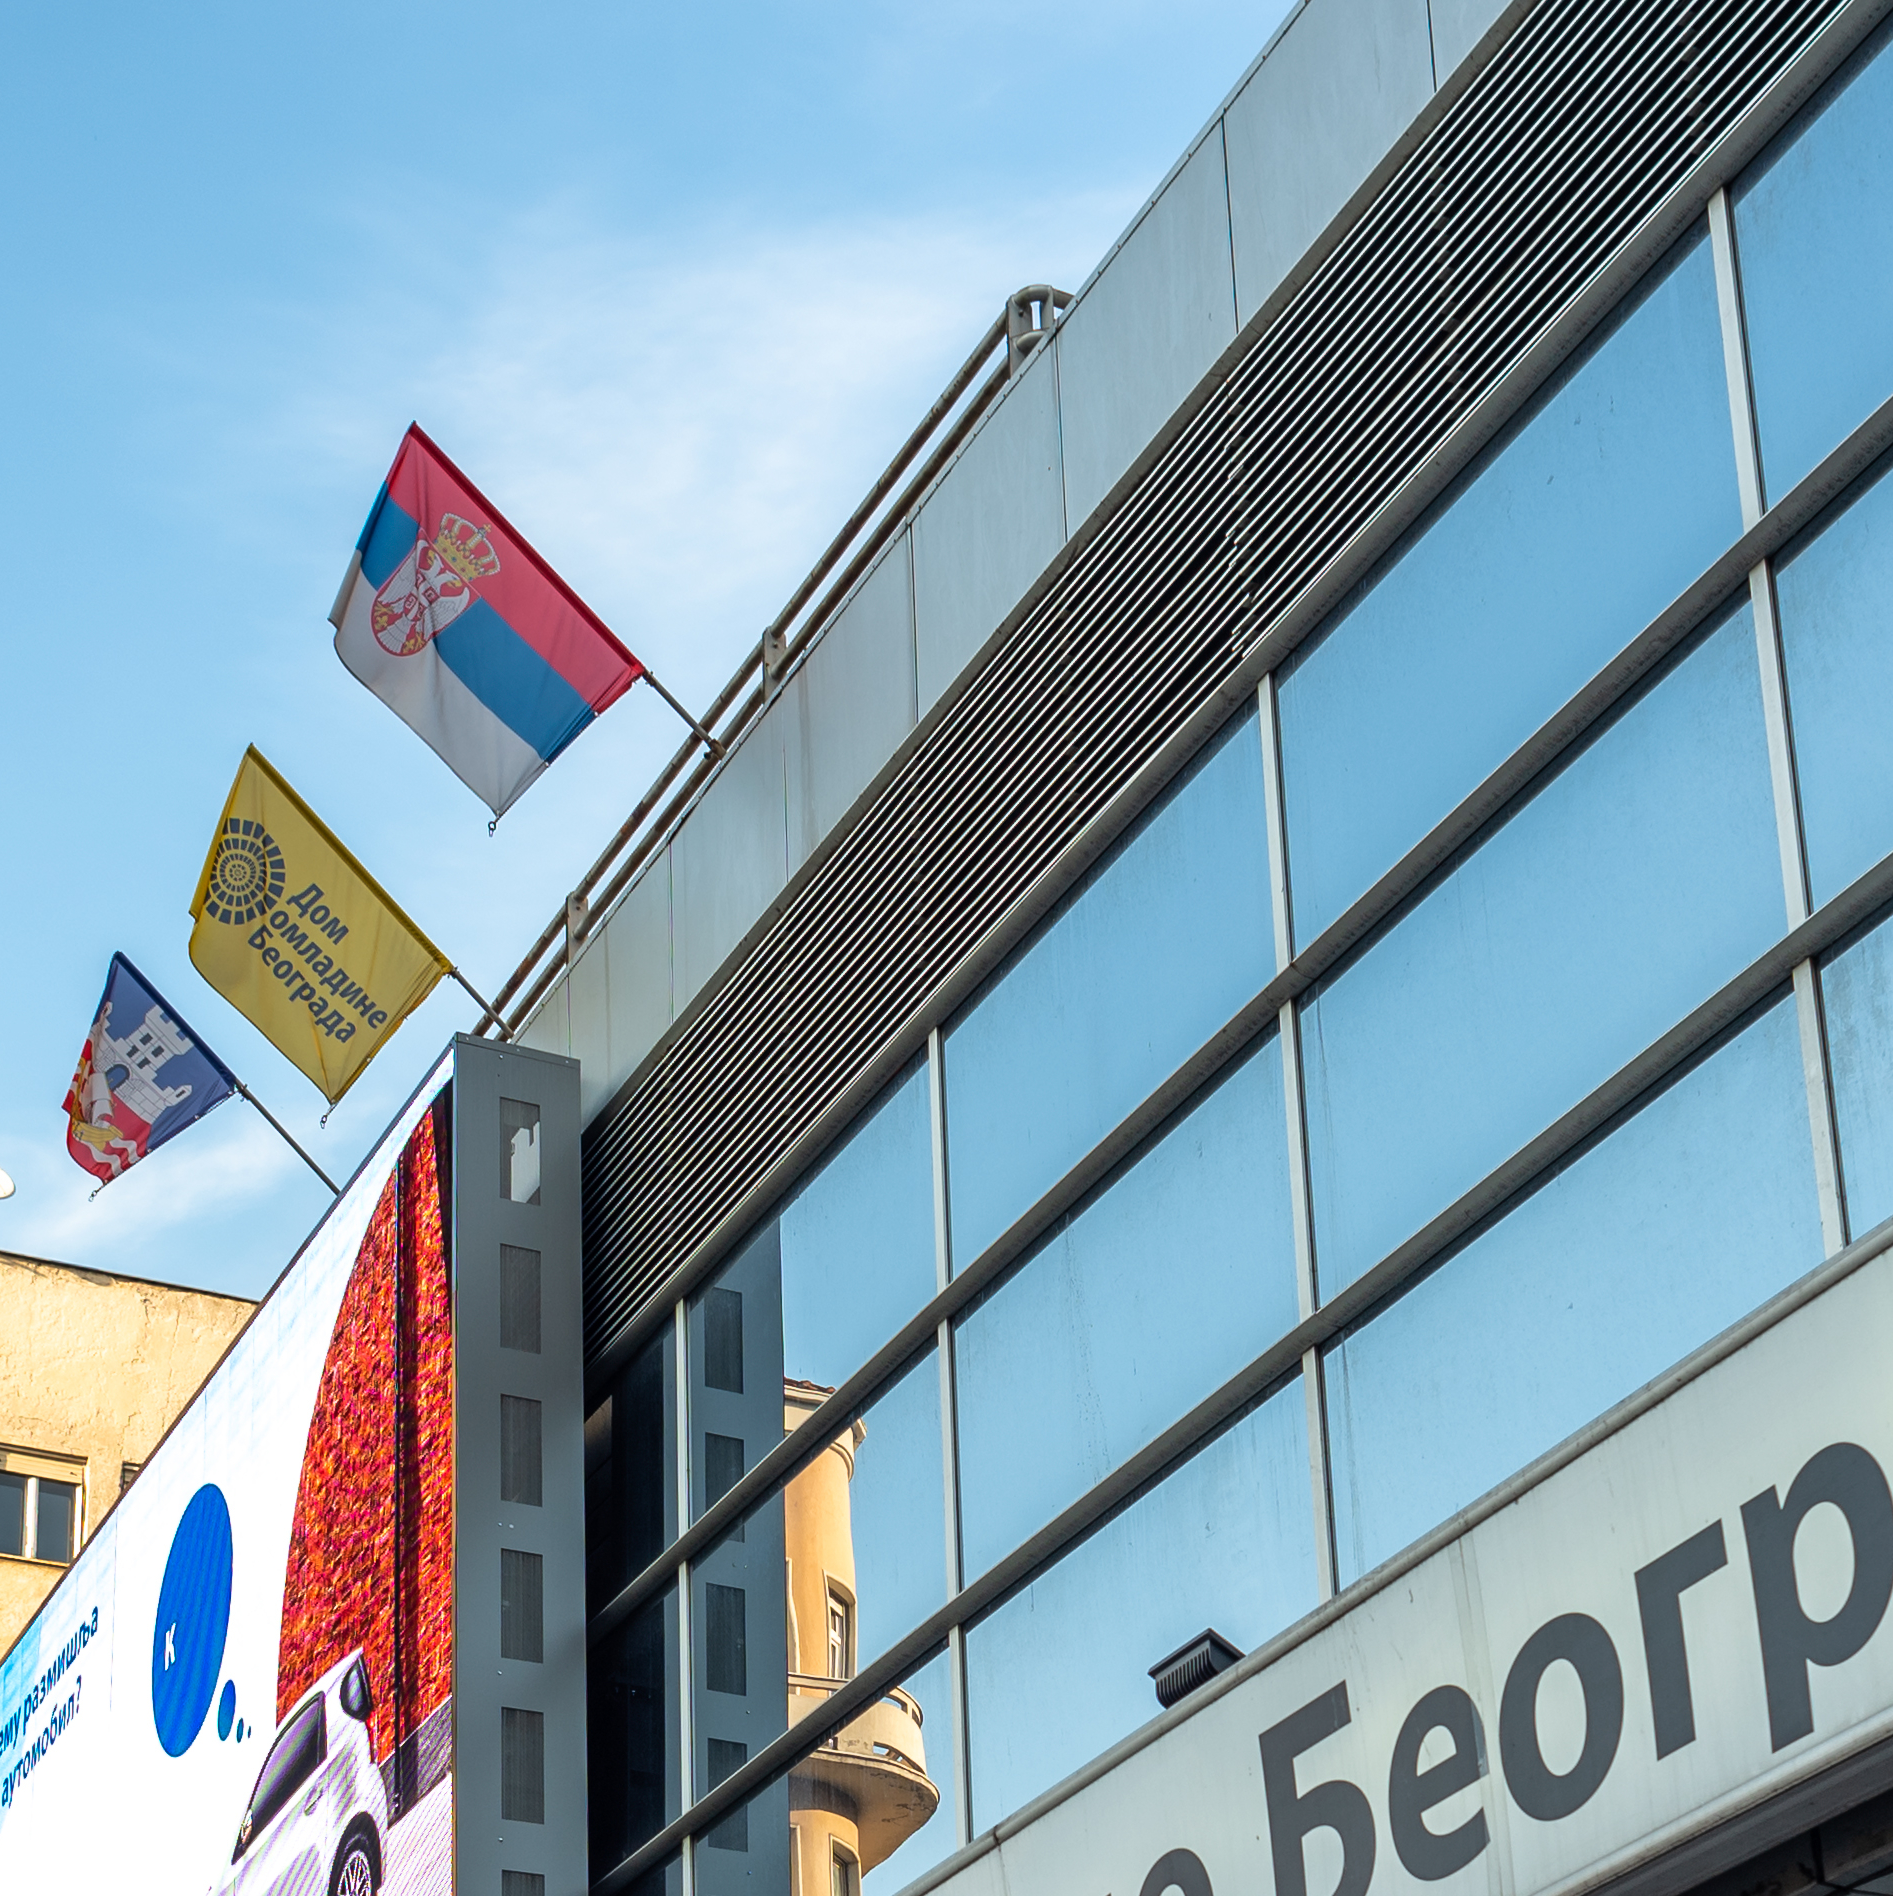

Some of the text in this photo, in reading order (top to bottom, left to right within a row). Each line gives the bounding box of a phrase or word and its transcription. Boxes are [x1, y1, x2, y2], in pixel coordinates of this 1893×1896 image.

[269, 910, 388, 1030] омладине
[286, 883, 349, 946] Дом
[247, 924, 356, 1043] Београда
[23, 1606, 99, 1736] размишља
